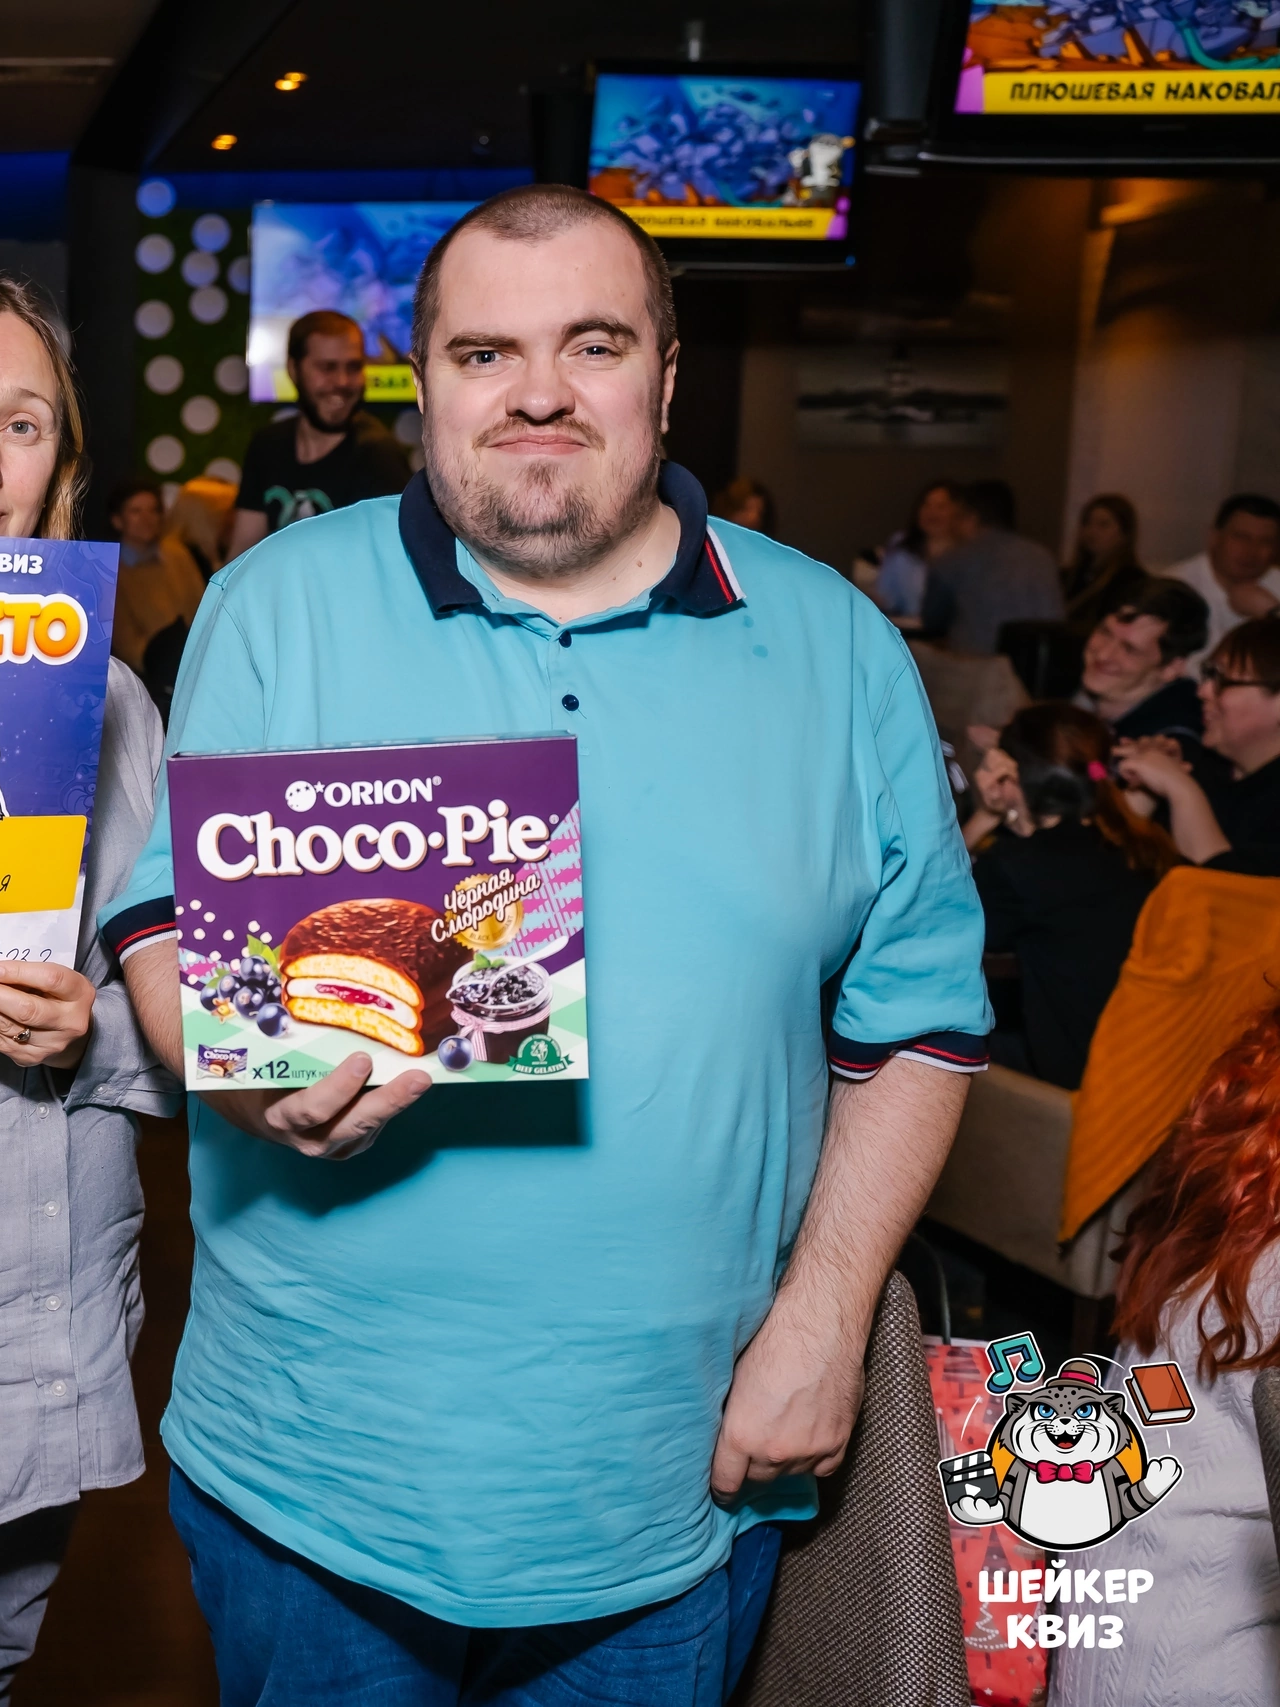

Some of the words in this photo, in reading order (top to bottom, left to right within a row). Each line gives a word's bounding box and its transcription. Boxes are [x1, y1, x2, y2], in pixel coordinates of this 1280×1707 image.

[1010, 82, 1156, 101] ПЛЮШЕВАЯ
[323, 777, 434, 808] ORION
[431, 873, 542, 943] Смородина
[443, 867, 515, 914] Чёрная
